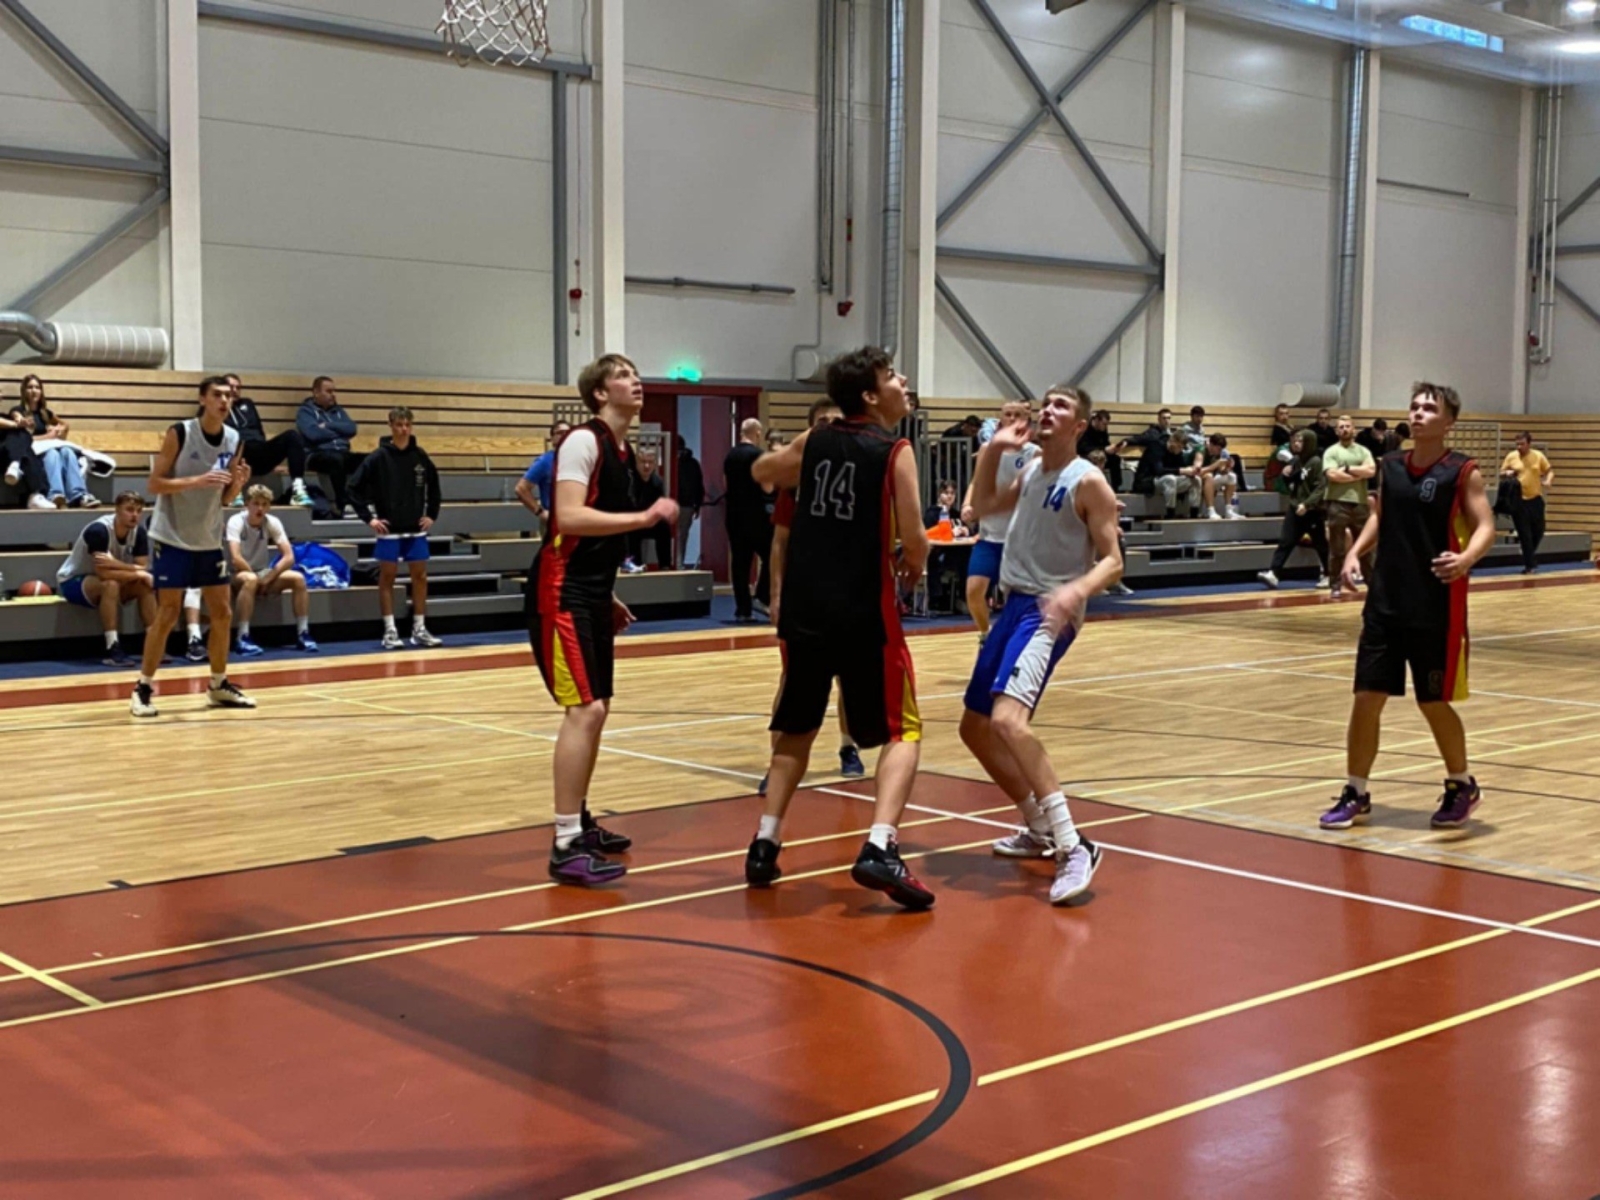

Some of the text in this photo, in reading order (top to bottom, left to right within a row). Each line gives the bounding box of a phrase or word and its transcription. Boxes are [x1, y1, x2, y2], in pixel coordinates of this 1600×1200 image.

[1015, 457, 1025, 469] 6
[811, 459, 857, 521] 14
[1043, 484, 1067, 512] 14
[1419, 478, 1437, 503] 9
